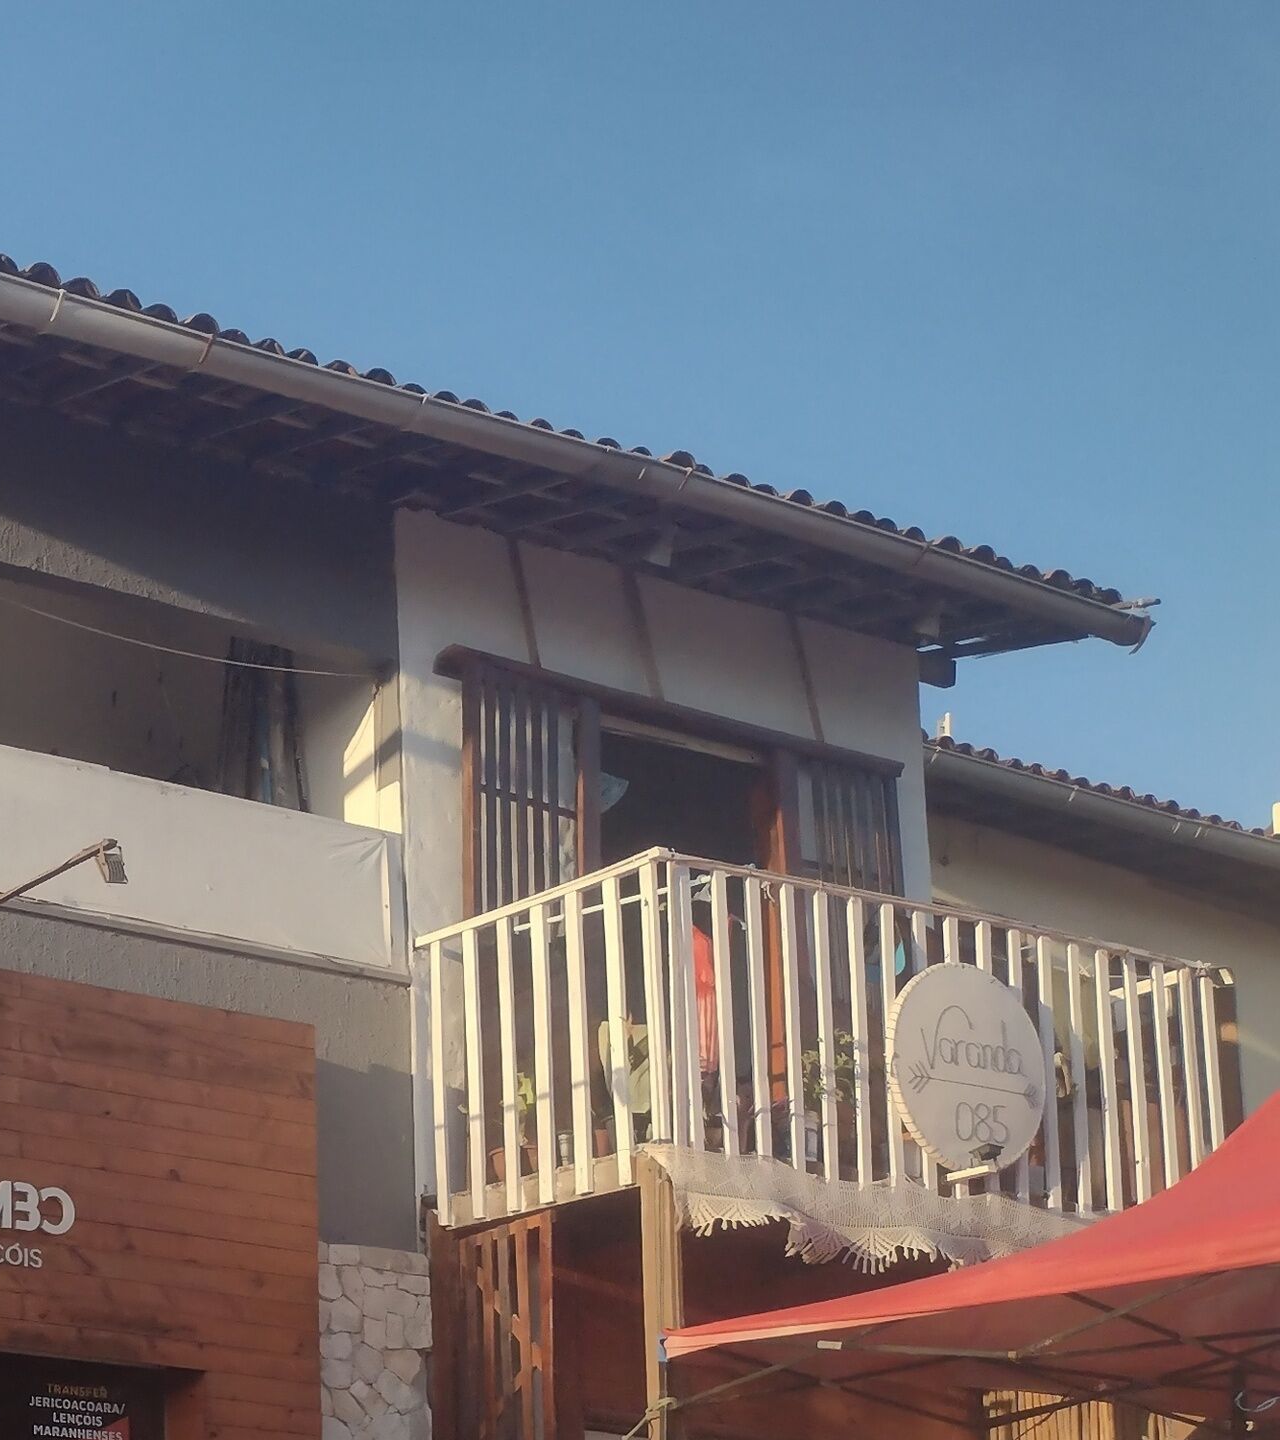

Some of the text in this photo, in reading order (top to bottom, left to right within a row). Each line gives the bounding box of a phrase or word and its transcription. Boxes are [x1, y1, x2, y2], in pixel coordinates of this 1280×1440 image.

[920, 1005, 1026, 1076] Varanda
[955, 1101, 1011, 1144] 085
[47, 1383, 108, 1398] TRANSFER
[28, 1396, 126, 1415] JERICOACOARA/
[52, 1412, 103, 1427] LENÇÓIS
